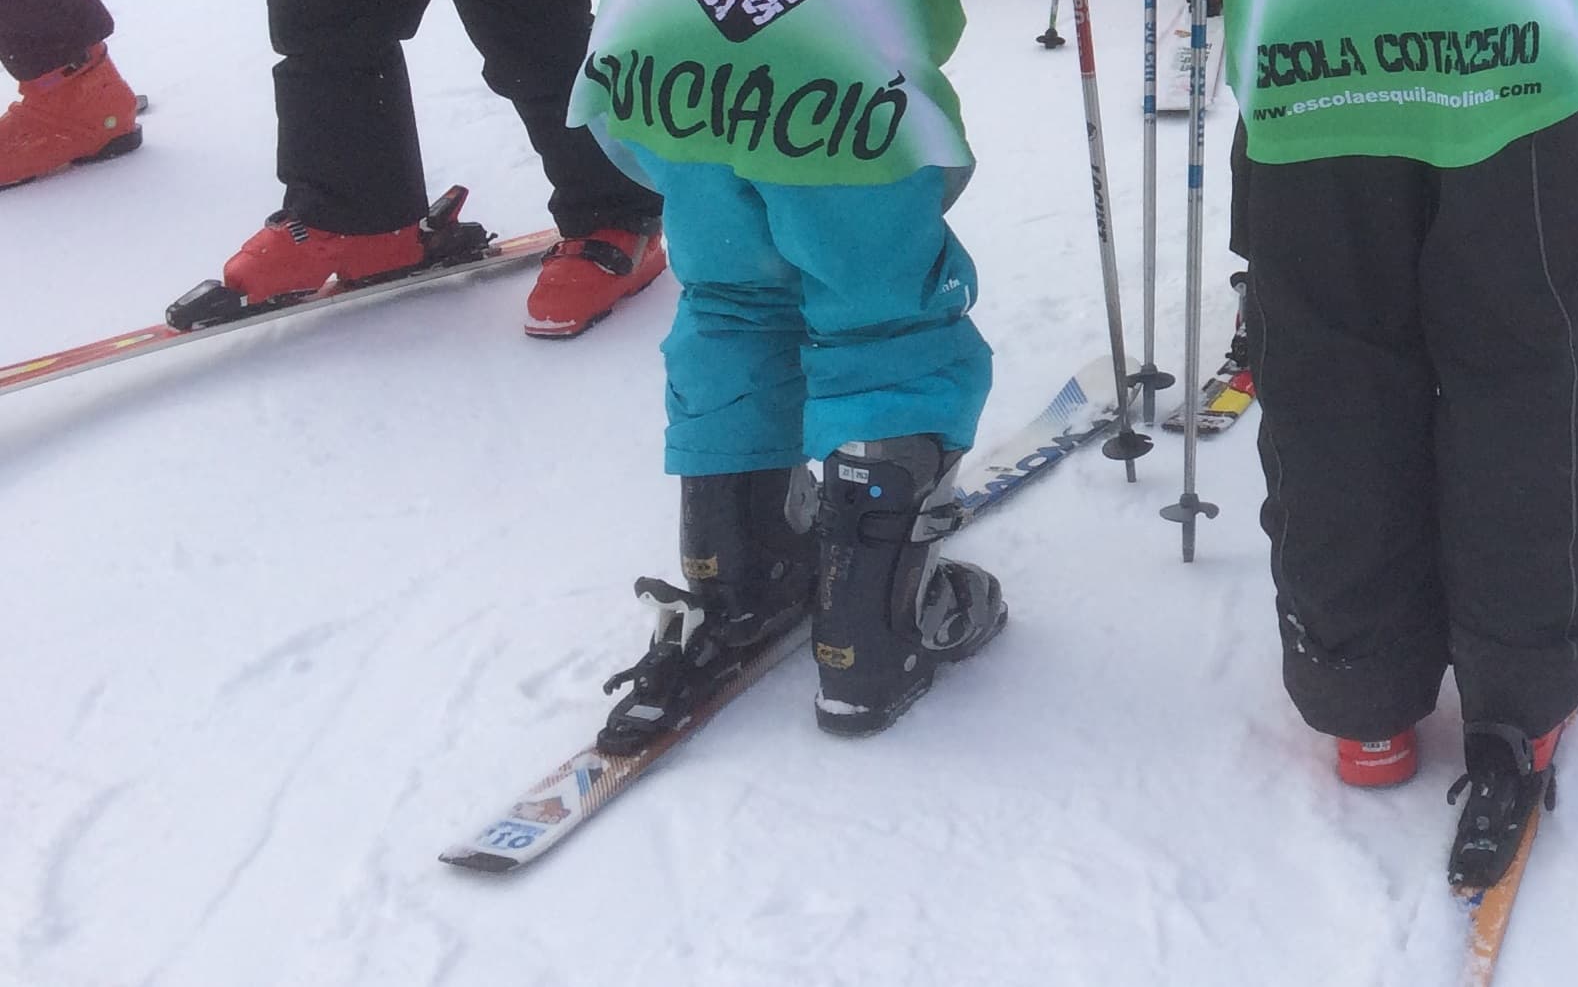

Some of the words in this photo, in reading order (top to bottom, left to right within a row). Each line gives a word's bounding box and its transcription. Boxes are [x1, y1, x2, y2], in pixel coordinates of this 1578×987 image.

[1256, 36, 1368, 89] SCOLA
[1373, 21, 1540, 76] COTA2500
[1252, 80, 1542, 121] ww.escolaesquilamolina.com
